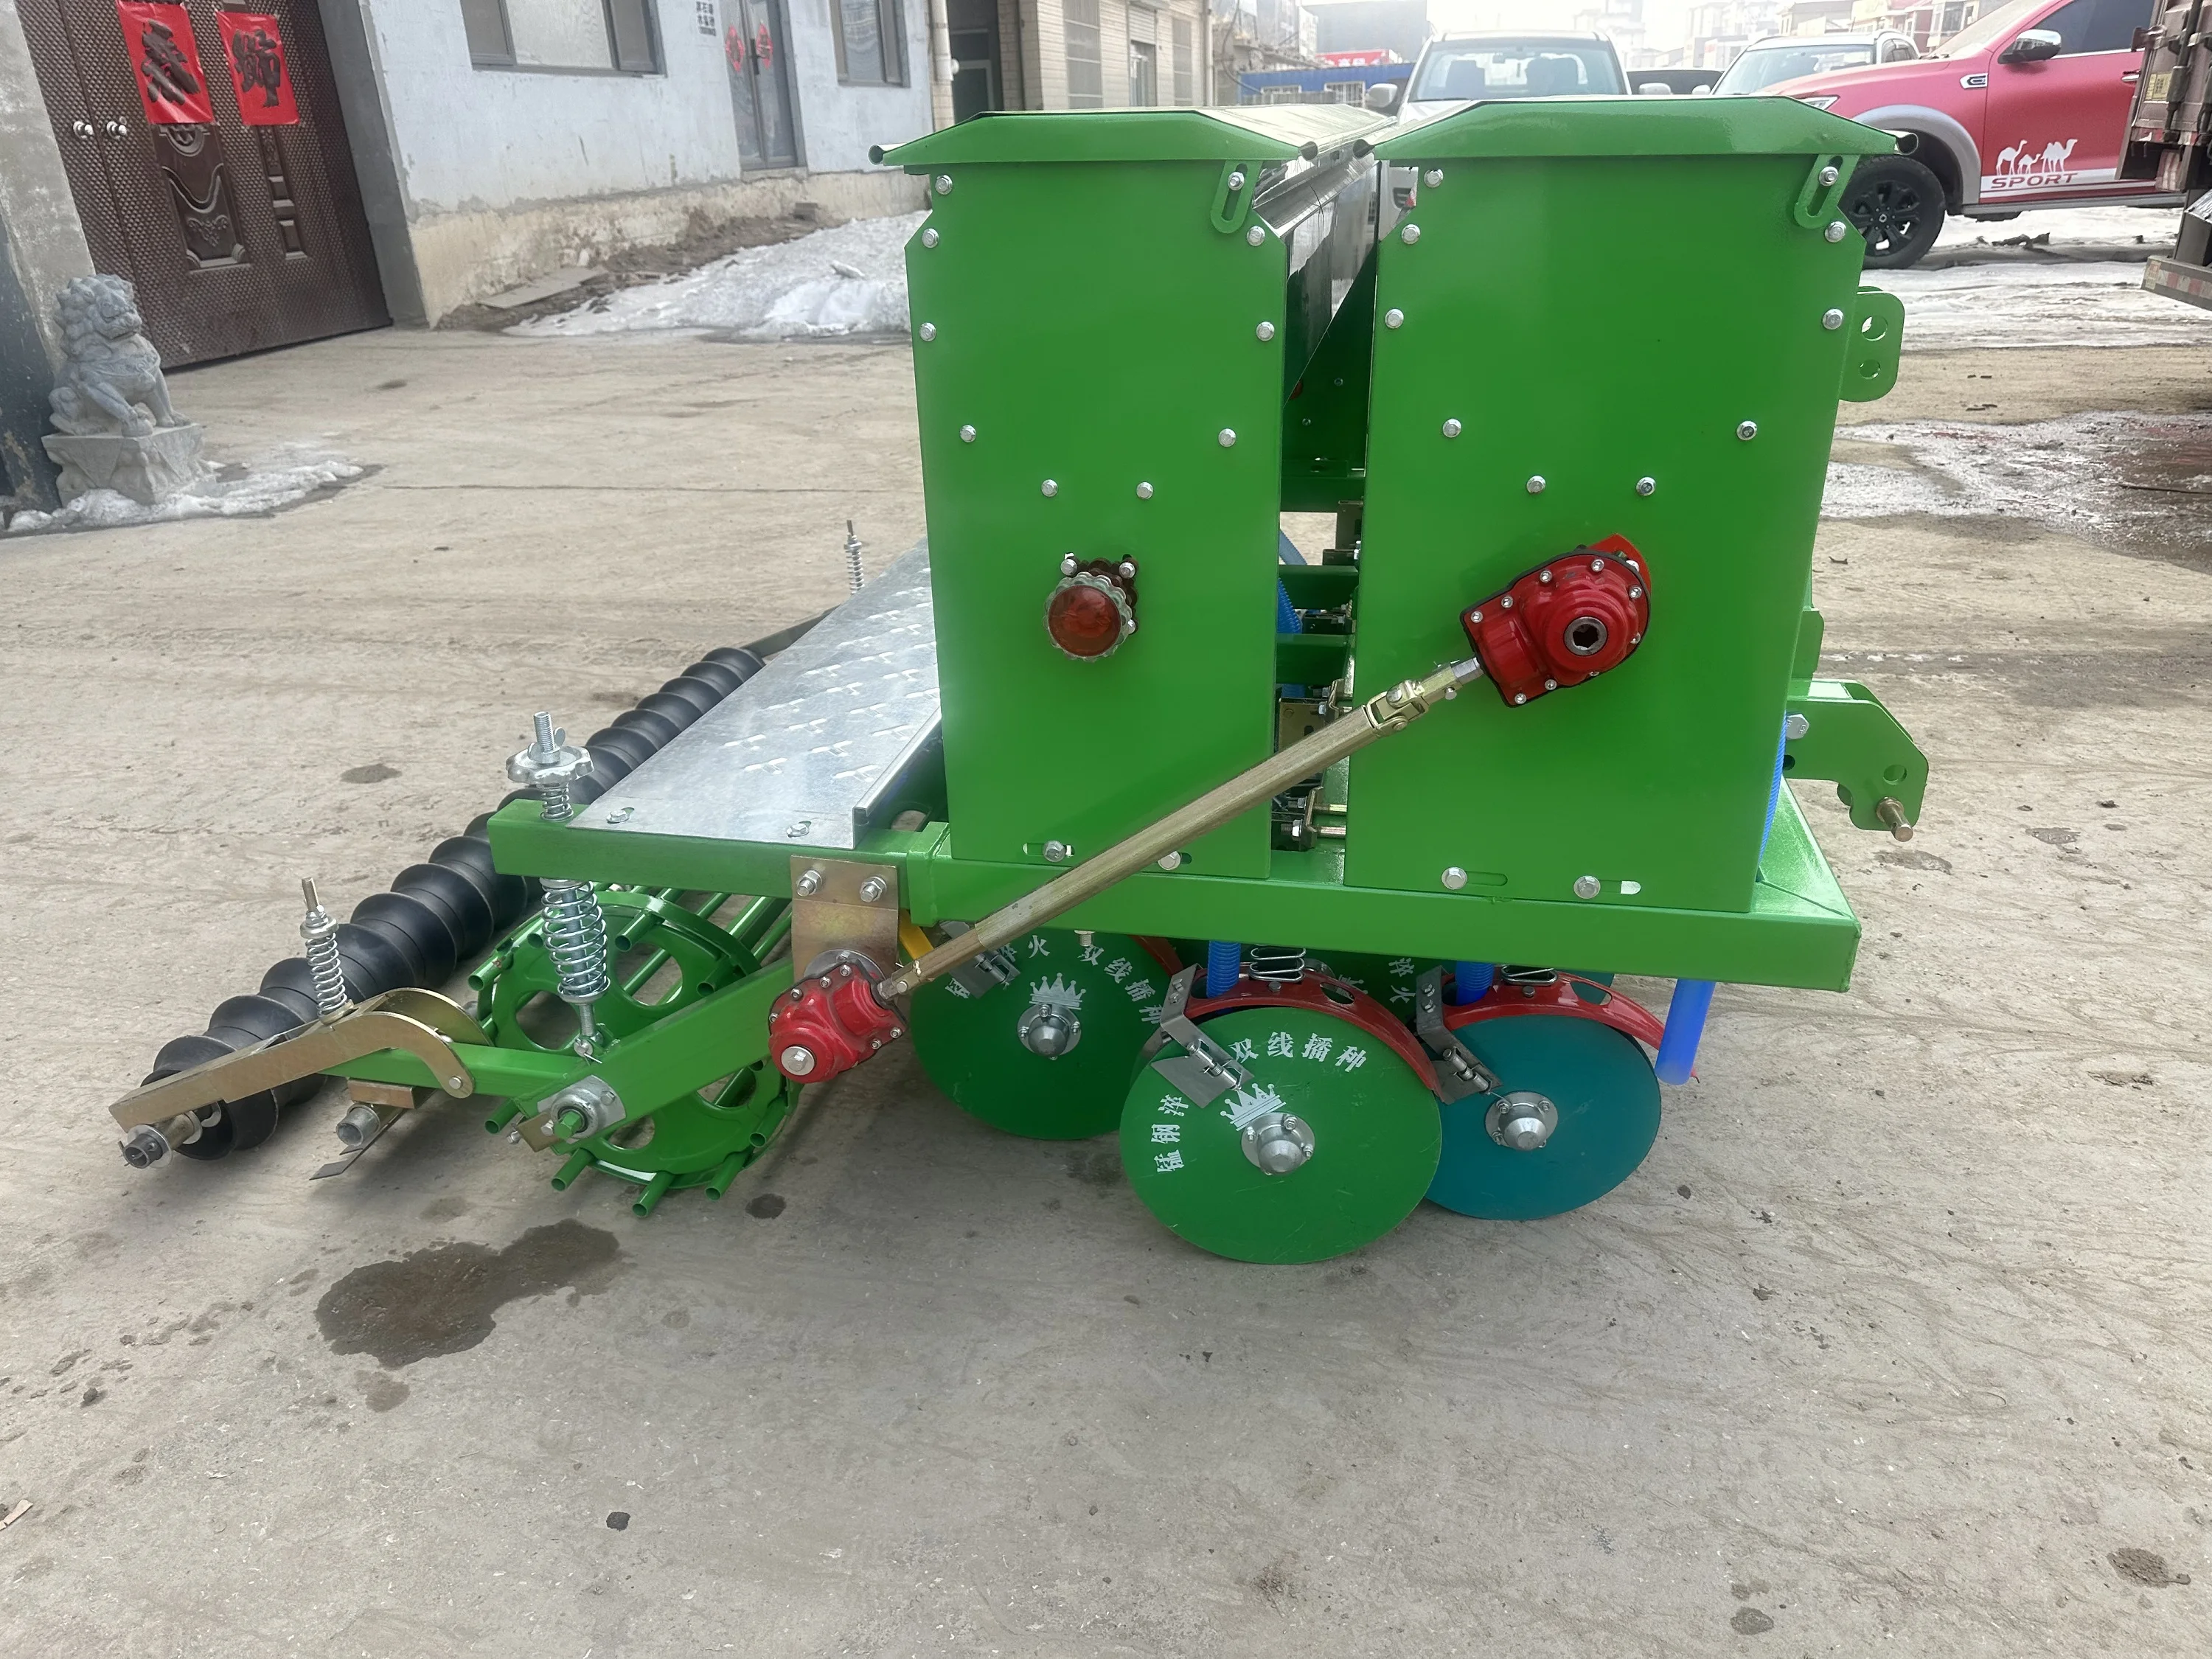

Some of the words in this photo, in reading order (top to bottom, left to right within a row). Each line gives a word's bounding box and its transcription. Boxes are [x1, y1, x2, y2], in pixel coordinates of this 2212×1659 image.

[1991, 173, 2078, 189] SPORT
[1150, 1093, 1189, 1172] 锰钢淬
[1225, 1031, 1368, 1073] 双线播种
